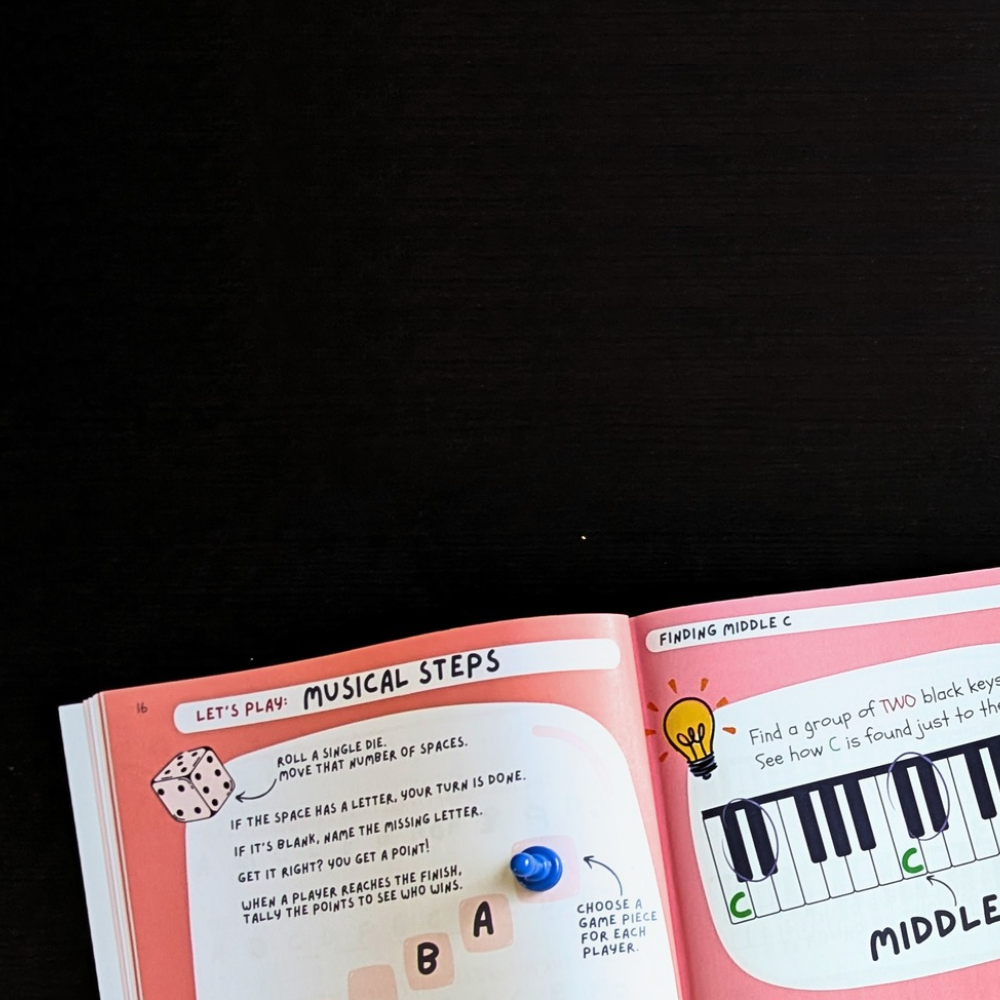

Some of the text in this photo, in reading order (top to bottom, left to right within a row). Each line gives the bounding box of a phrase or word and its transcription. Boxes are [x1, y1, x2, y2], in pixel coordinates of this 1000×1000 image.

[660, 616, 791, 646] FINDING MIDDLE C
[197, 649, 499, 721] LET'S PLAY: MUSICAL STEPS
[137, 702, 148, 714] 16
[749, 723, 782, 745] Find
[789, 726, 798, 735] a
[805, 712, 851, 739] group
[858, 700, 875, 718] of
[879, 694, 916, 713] TWO
[921, 682, 964, 703] black
[278, 737, 387, 767] ROLL A SINGLE DIE.
[755, 753, 784, 769] See
[789, 746, 823, 761] how
[829, 736, 840, 751] C
[846, 737, 861, 749] is
[865, 719, 912, 743] found
[916, 710, 949, 739] just
[955, 707, 974, 723] to
[279, 737, 467, 781] MOVE THAT NUMBER OF SPACES.
[231, 770, 525, 830] IF THE SPACE HAS A LETTER, YOUR TURN IS DONE.
[235, 806, 482, 857] IF IT'S BLANK, NAME THE MISSING LETTER.
[238, 838, 429, 882] GET IT RIGHT? YOU GET A POINT!
[902, 848, 924, 873] C
[242, 865, 461, 910] WHEN A PLAYER REACHES THE FINISH,
[244, 880, 462, 924] TALLY THE POINTS TO SEE WHO WINS.
[474, 901, 494, 937] A
[577, 899, 642, 914] CHOOSE A
[579, 911, 657, 928] GAME PIECE
[730, 892, 752, 918] C
[582, 927, 645, 944] FOR EACH
[583, 943, 639, 958] PLAYER.
[418, 942, 439, 975] B
